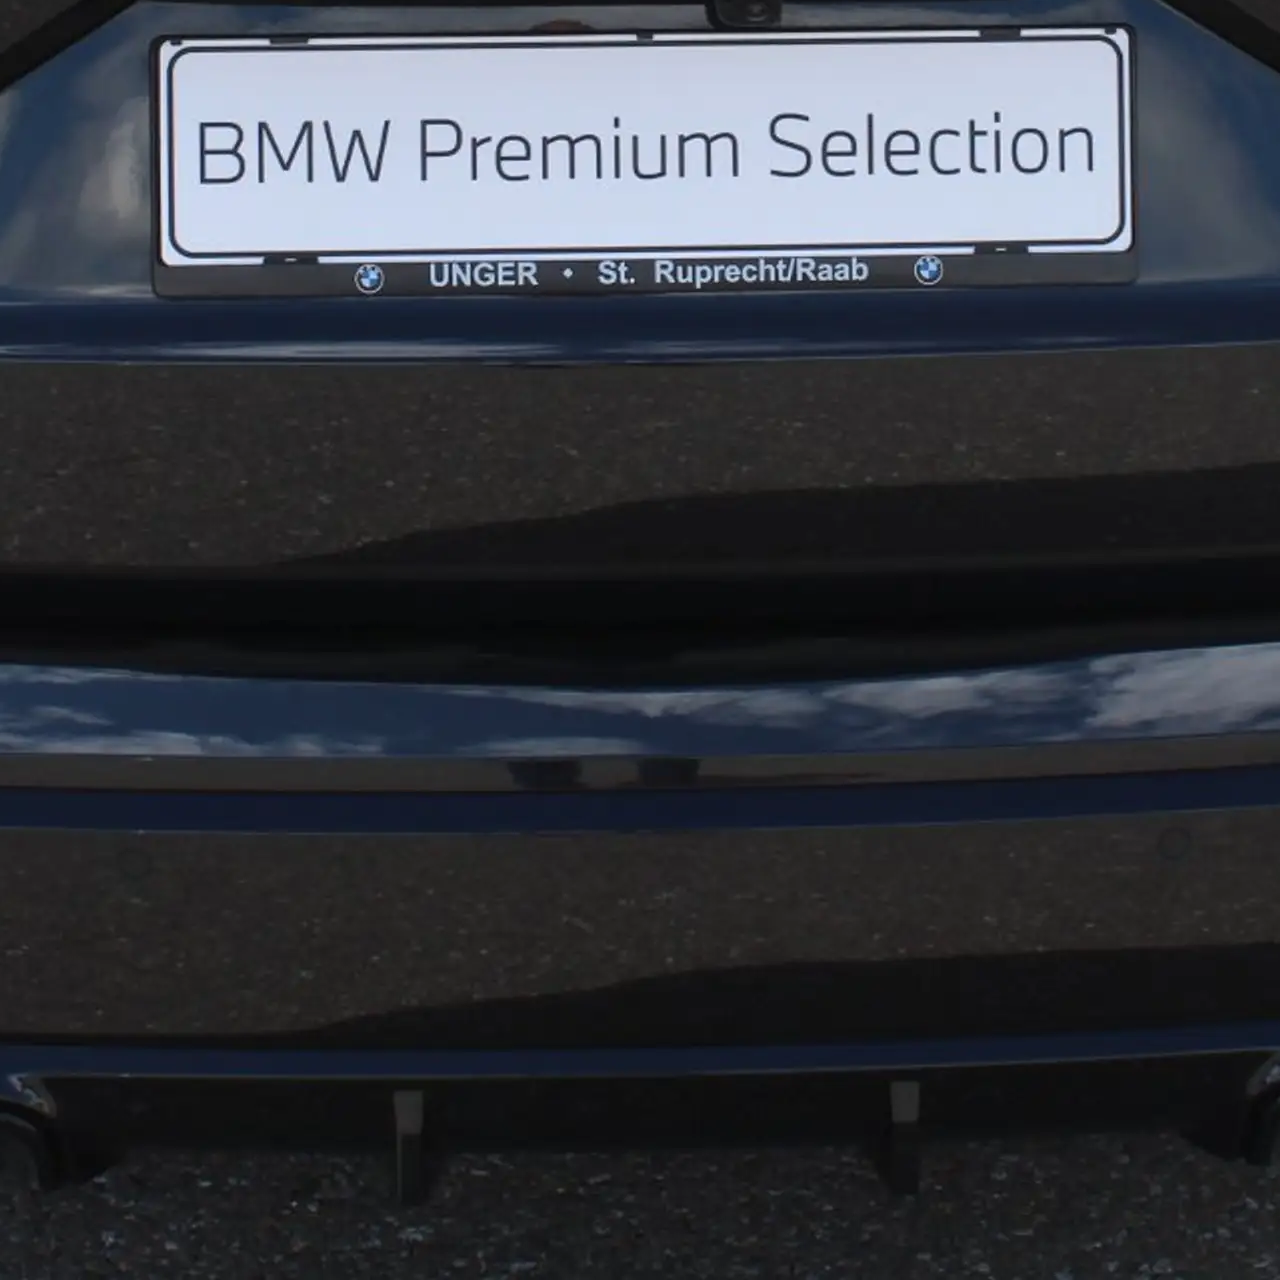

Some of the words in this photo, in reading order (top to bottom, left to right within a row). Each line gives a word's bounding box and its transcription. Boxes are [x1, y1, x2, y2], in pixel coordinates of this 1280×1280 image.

[198, 119, 391, 184] BMW
[419, 116, 739, 182] Premium
[769, 111, 1095, 178] Selection
[428, 260, 540, 287] UNGER
[597, 259, 636, 285] St.
[653, 257, 869, 290] Ruprecht/Raab
